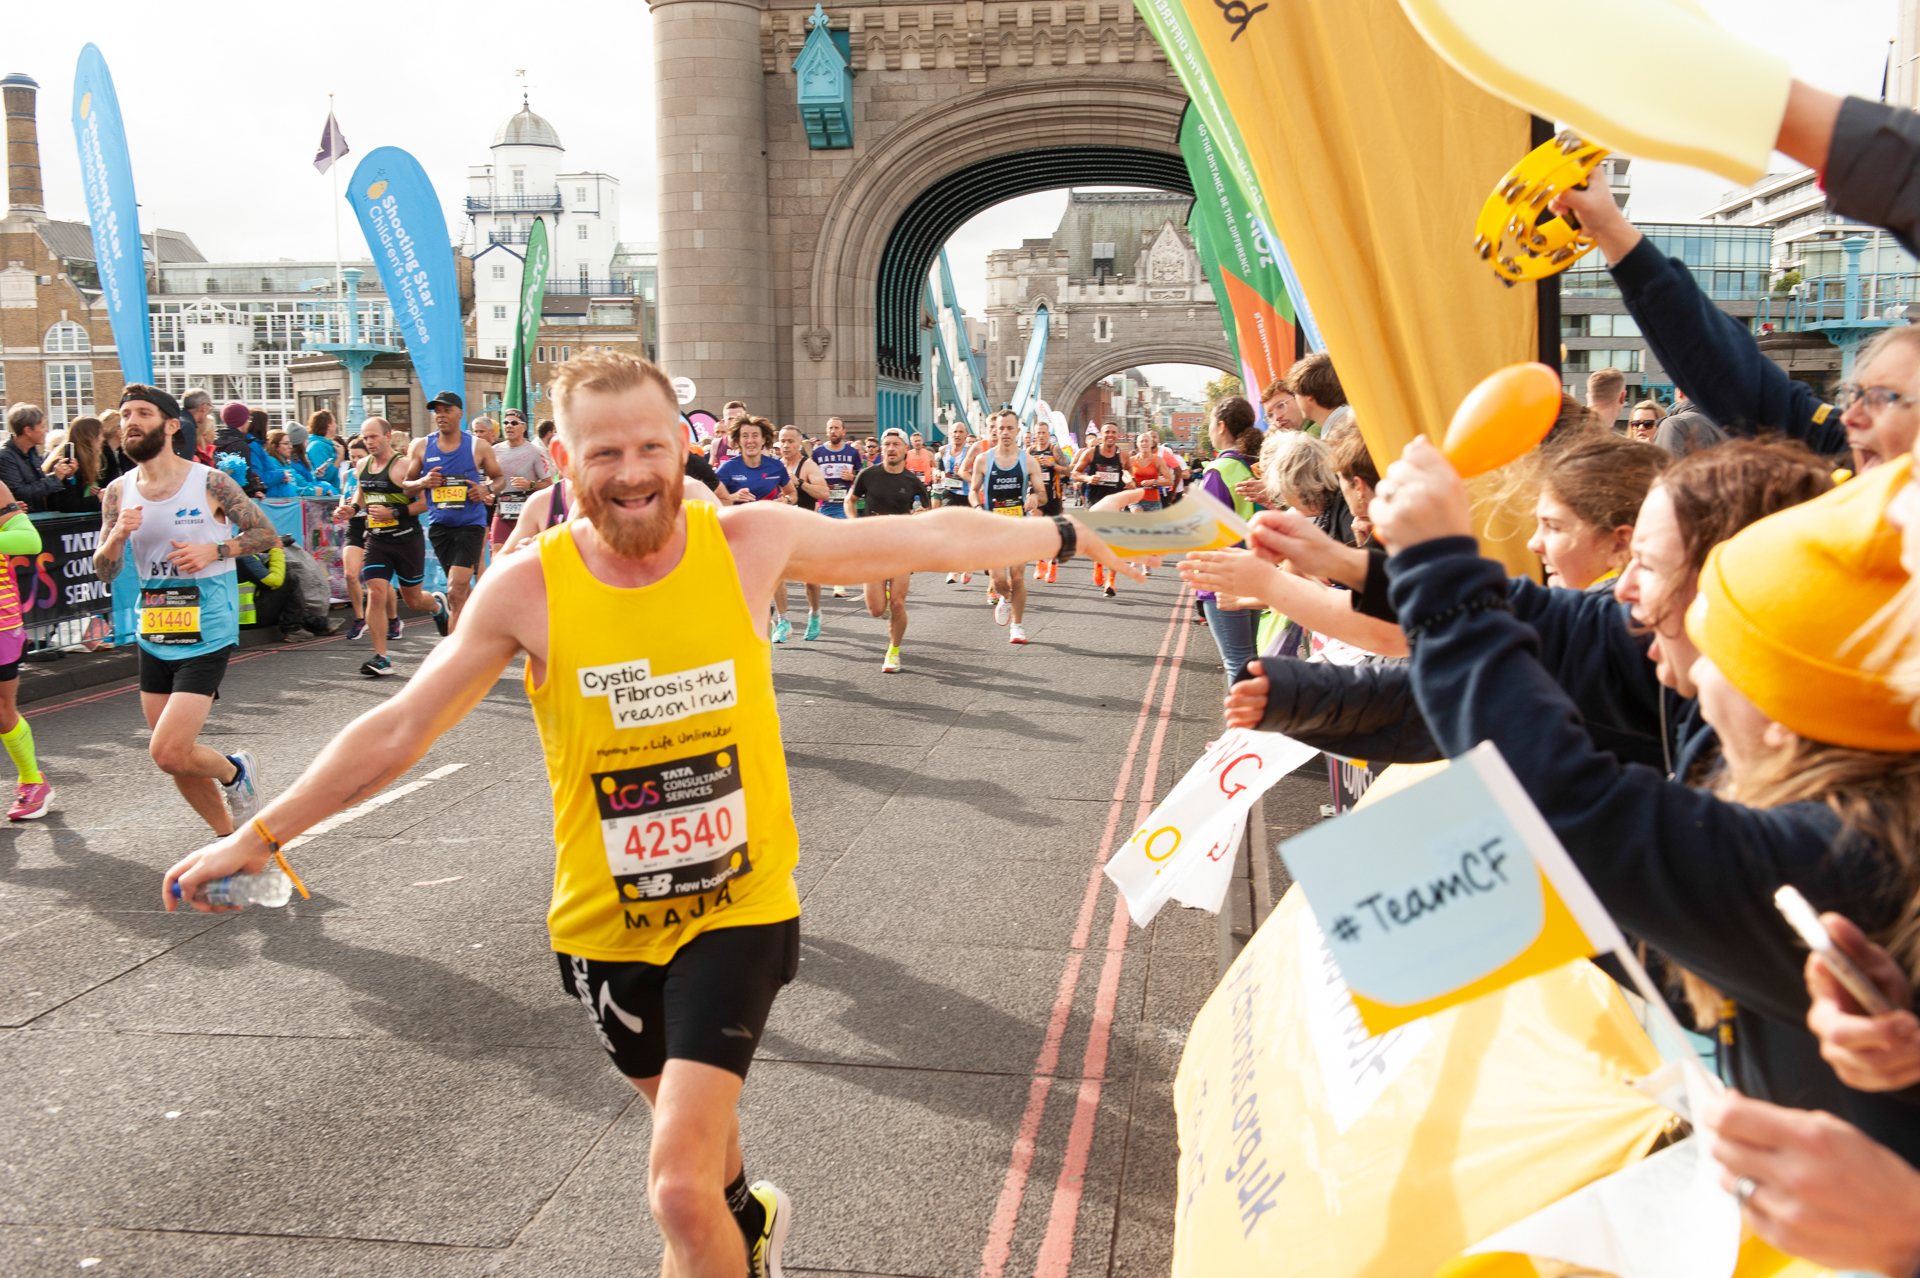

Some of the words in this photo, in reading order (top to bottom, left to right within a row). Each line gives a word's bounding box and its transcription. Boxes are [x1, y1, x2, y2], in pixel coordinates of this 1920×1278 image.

[1198, 124, 1207, 136] GO
[1202, 136, 1212, 158] THE
[1220, 196, 1229, 208] BE
[1224, 207, 1235, 226] THE
[107, 211, 122, 260] Star
[382, 195, 420, 273] Shooting
[414, 271, 435, 307] Star
[369, 206, 404, 277] Children's
[399, 276, 430, 344] Hospices
[818, 455, 852, 463] MARTIN
[436, 488, 464, 499] 31540
[147, 611, 192, 628] 31440
[584, 666, 646, 690] Cystic
[696, 669, 729, 687] the
[619, 700, 689, 723] reason
[691, 695, 696, 708] I
[700, 689, 734, 707] run
[650, 735, 674, 750] Life
[660, 766, 694, 780] TATA
[663, 765, 732, 791] CONSULTANCY
[665, 785, 713, 802] SERVICES
[624, 806, 732, 860] 42540
[675, 881, 700, 893] new
[1331, 836, 1509, 942] #TeamCF
